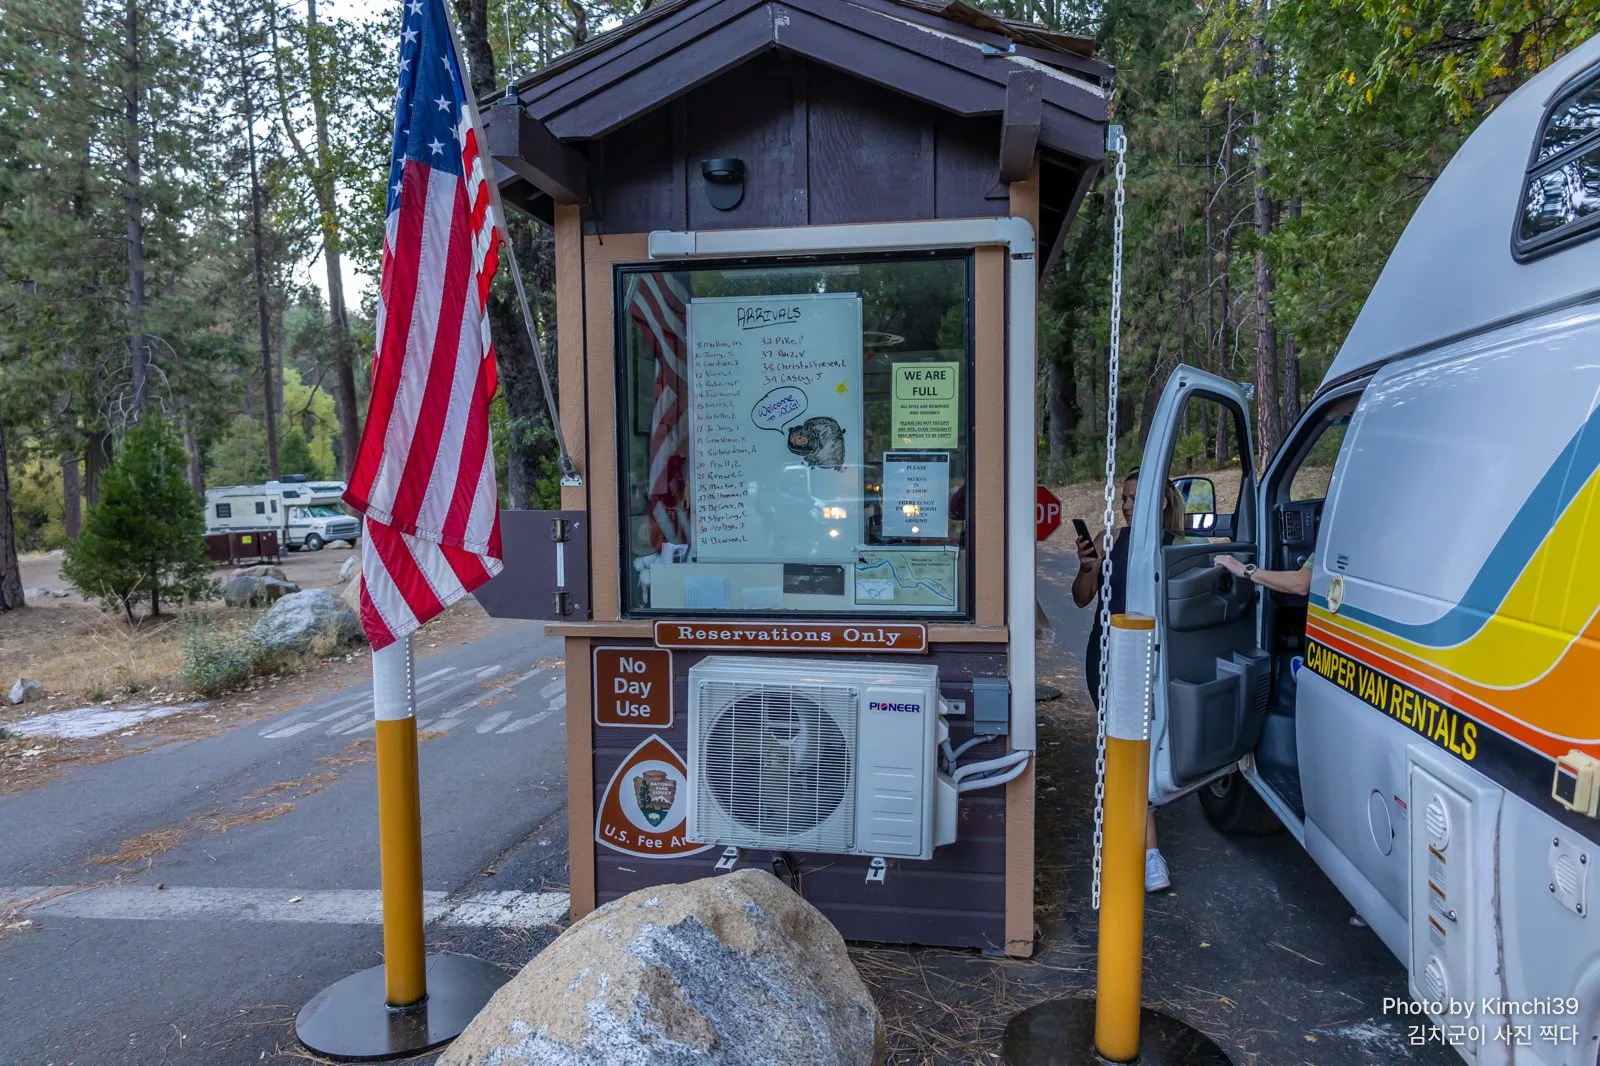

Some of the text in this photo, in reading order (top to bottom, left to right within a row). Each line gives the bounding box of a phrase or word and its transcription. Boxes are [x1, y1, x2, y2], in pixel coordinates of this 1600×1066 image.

[737, 306, 802, 328] ARRIVALS
[904, 370, 946, 381] WE ARE
[912, 386, 938, 396] FULL
[759, 394, 794, 417] Welcome
[1036, 503, 1059, 524] OP
[678, 626, 900, 646] Reservations Only
[619, 656, 647, 673] No
[614, 678, 652, 699] Day
[616, 700, 651, 717] Use
[869, 702, 921, 713] PIONEER
[1307, 642, 1477, 761] CAMPER VAN RENTALS
[604, 824, 687, 848] U.S. Fee Ar
